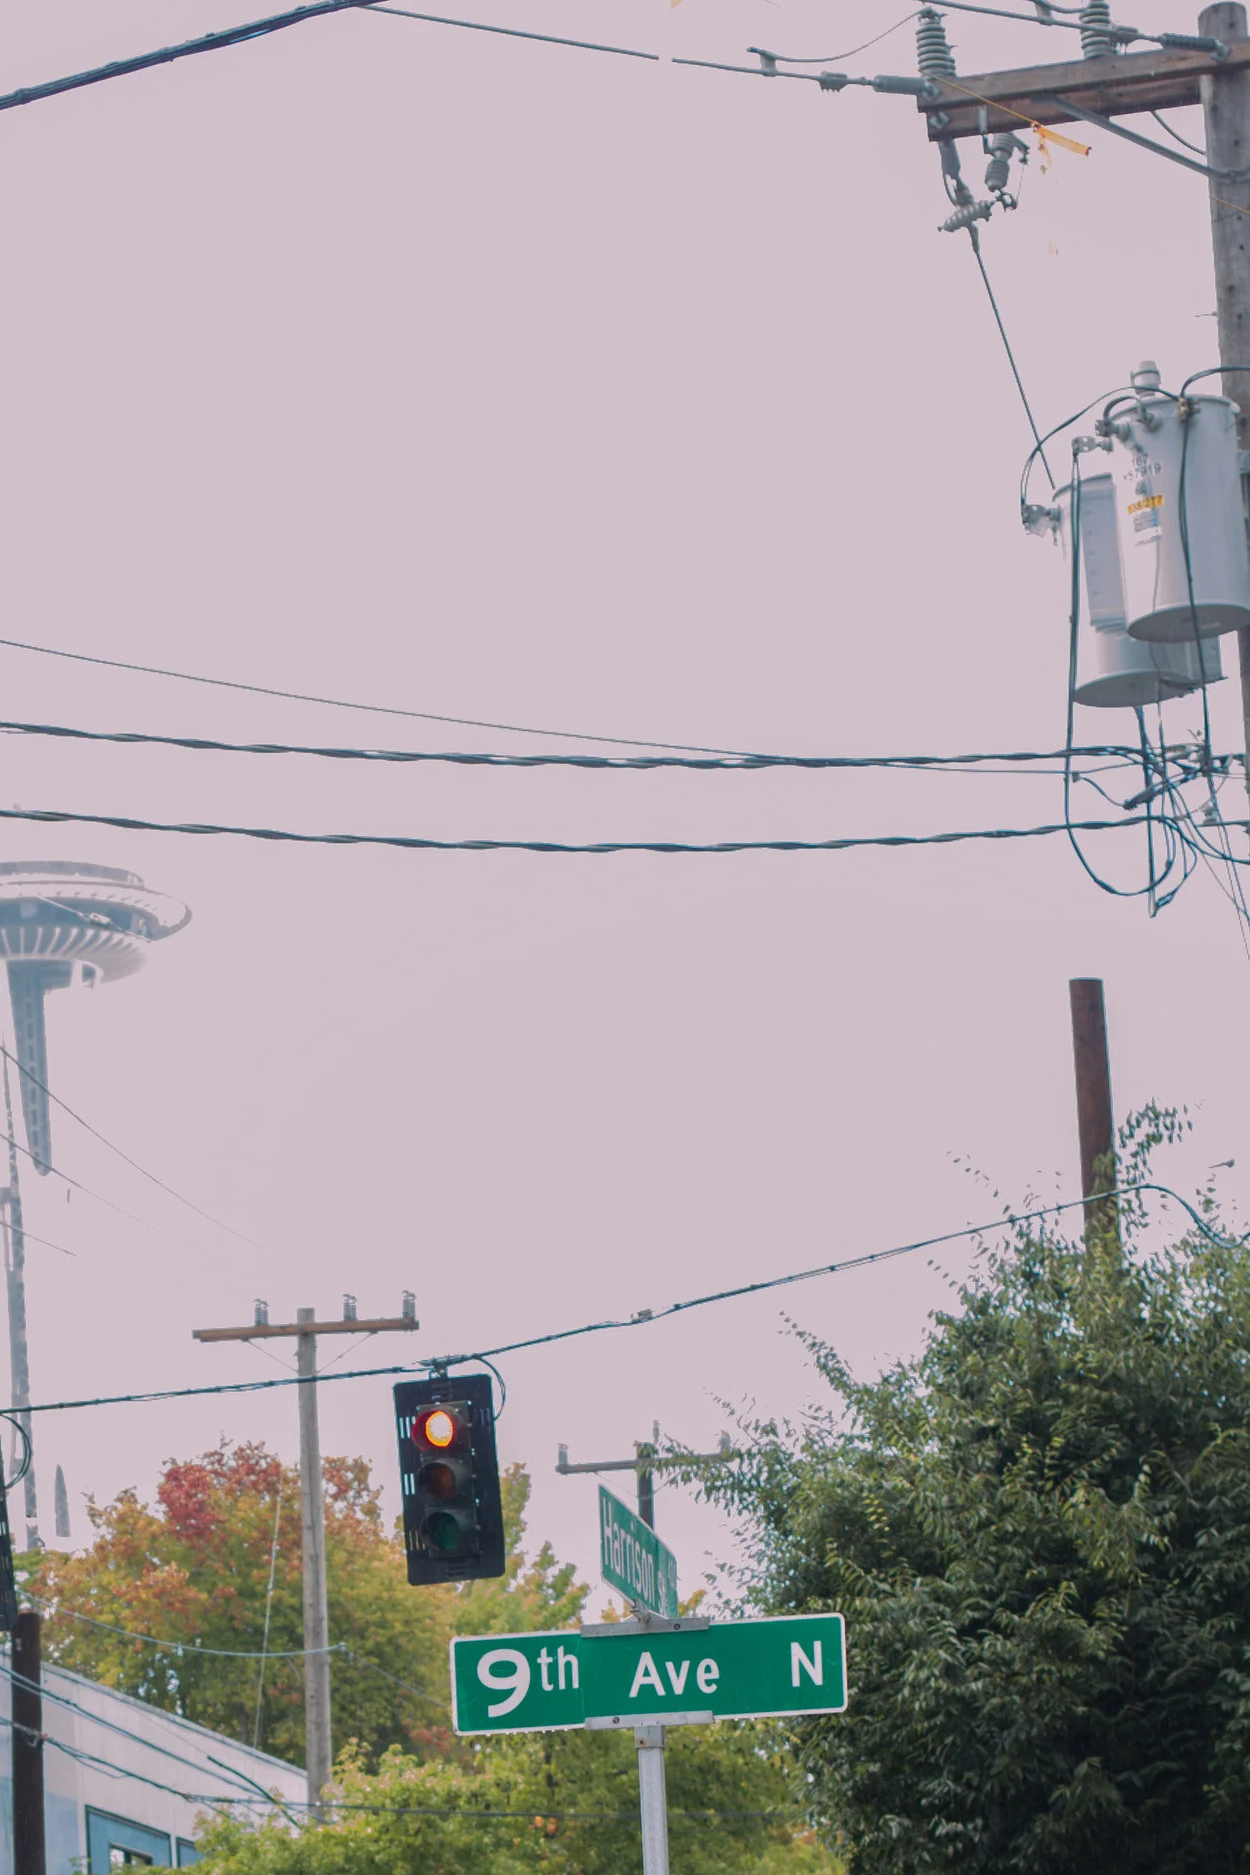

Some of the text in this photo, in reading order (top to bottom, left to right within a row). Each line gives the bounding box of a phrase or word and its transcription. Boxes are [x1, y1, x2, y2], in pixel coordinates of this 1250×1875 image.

[602, 1497, 656, 1607] Harrison
[477, 1641, 823, 1718] 9th Ave N
